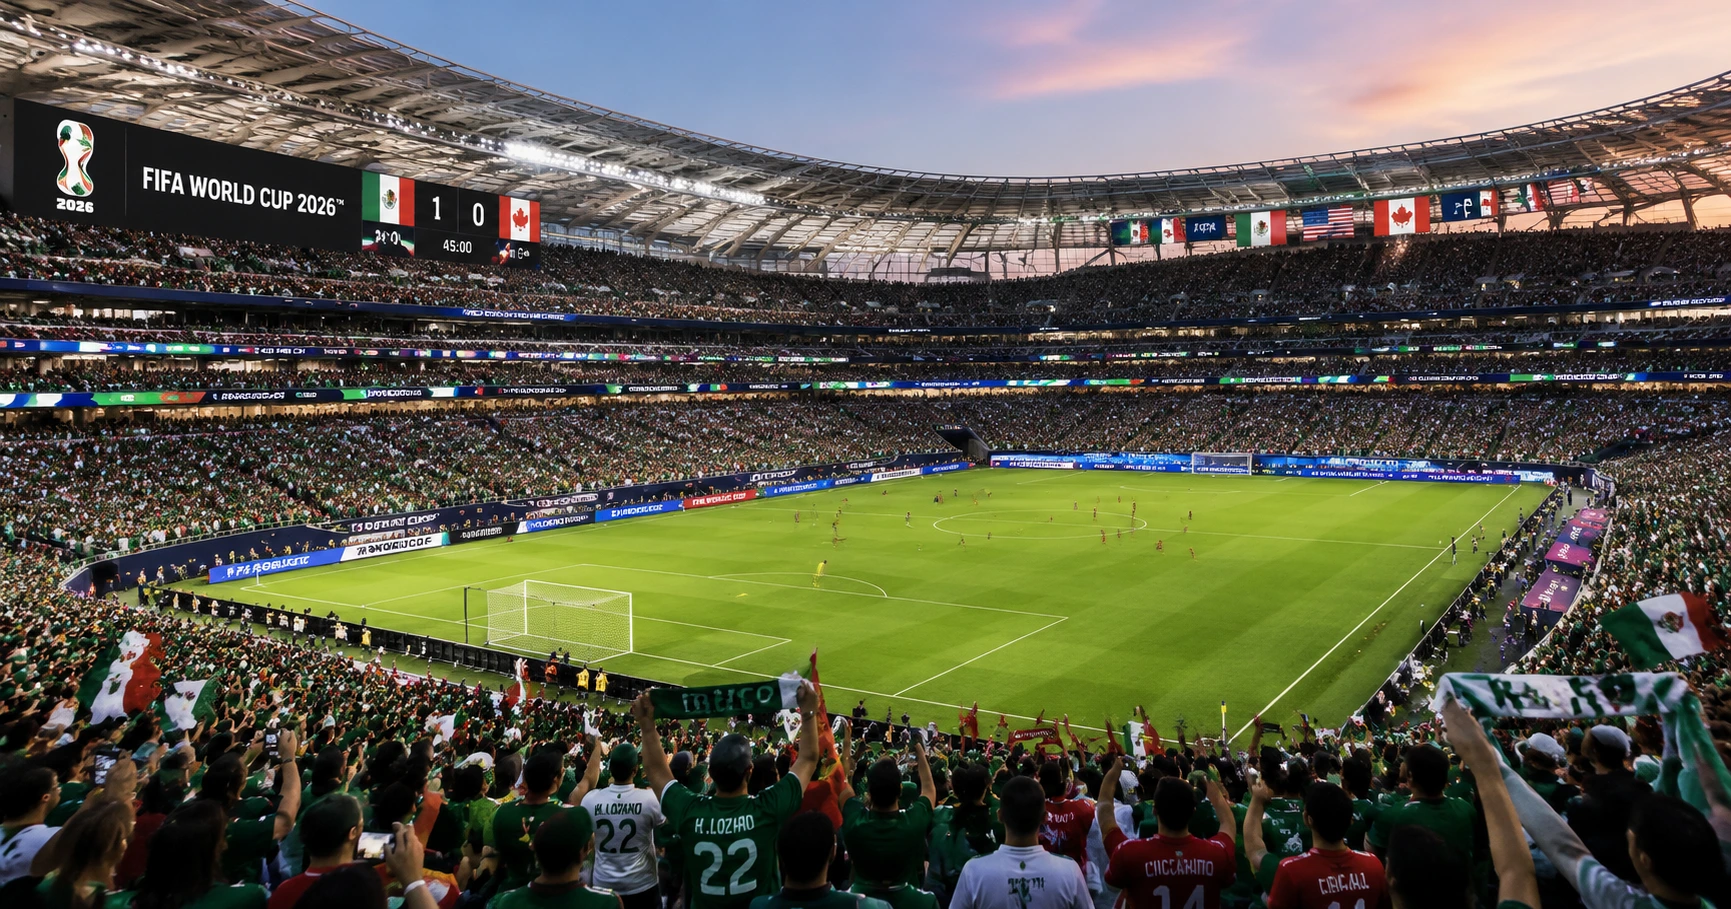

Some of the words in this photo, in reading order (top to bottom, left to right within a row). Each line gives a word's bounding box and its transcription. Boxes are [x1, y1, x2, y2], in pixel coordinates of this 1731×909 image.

[143, 166, 184, 196] FIFA
[189, 174, 255, 206] WORLD
[260, 187, 293, 212] CUP
[56, 198, 94, 213] 2026
[432, 196, 442, 221] 1
[472, 202, 485, 227] 0
[443, 239, 473, 255] 45:00
[595, 818, 641, 854] 22
[693, 838, 758, 896] 22
